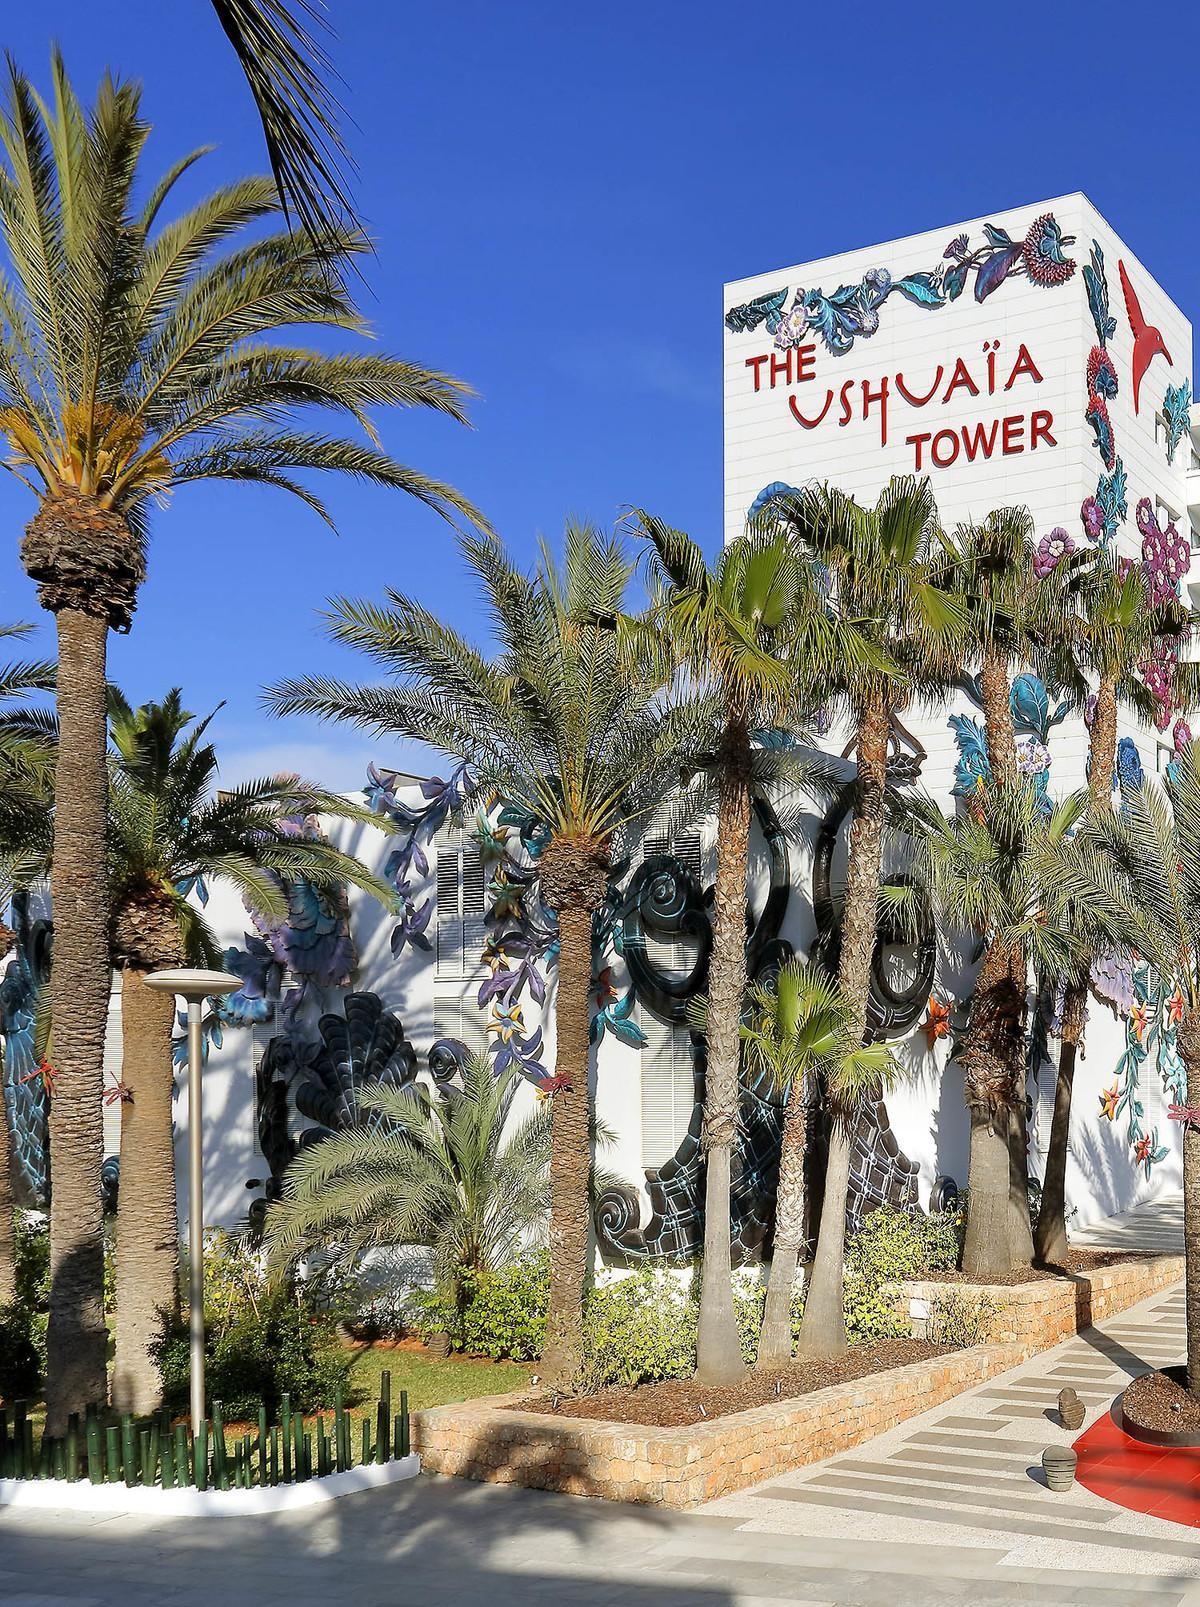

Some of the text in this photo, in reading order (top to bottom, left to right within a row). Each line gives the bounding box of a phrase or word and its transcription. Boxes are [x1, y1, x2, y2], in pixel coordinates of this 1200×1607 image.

[745, 343, 817, 392] THE
[788, 339, 1043, 448] USHUAÏA
[905, 409, 1058, 472] TOWER
